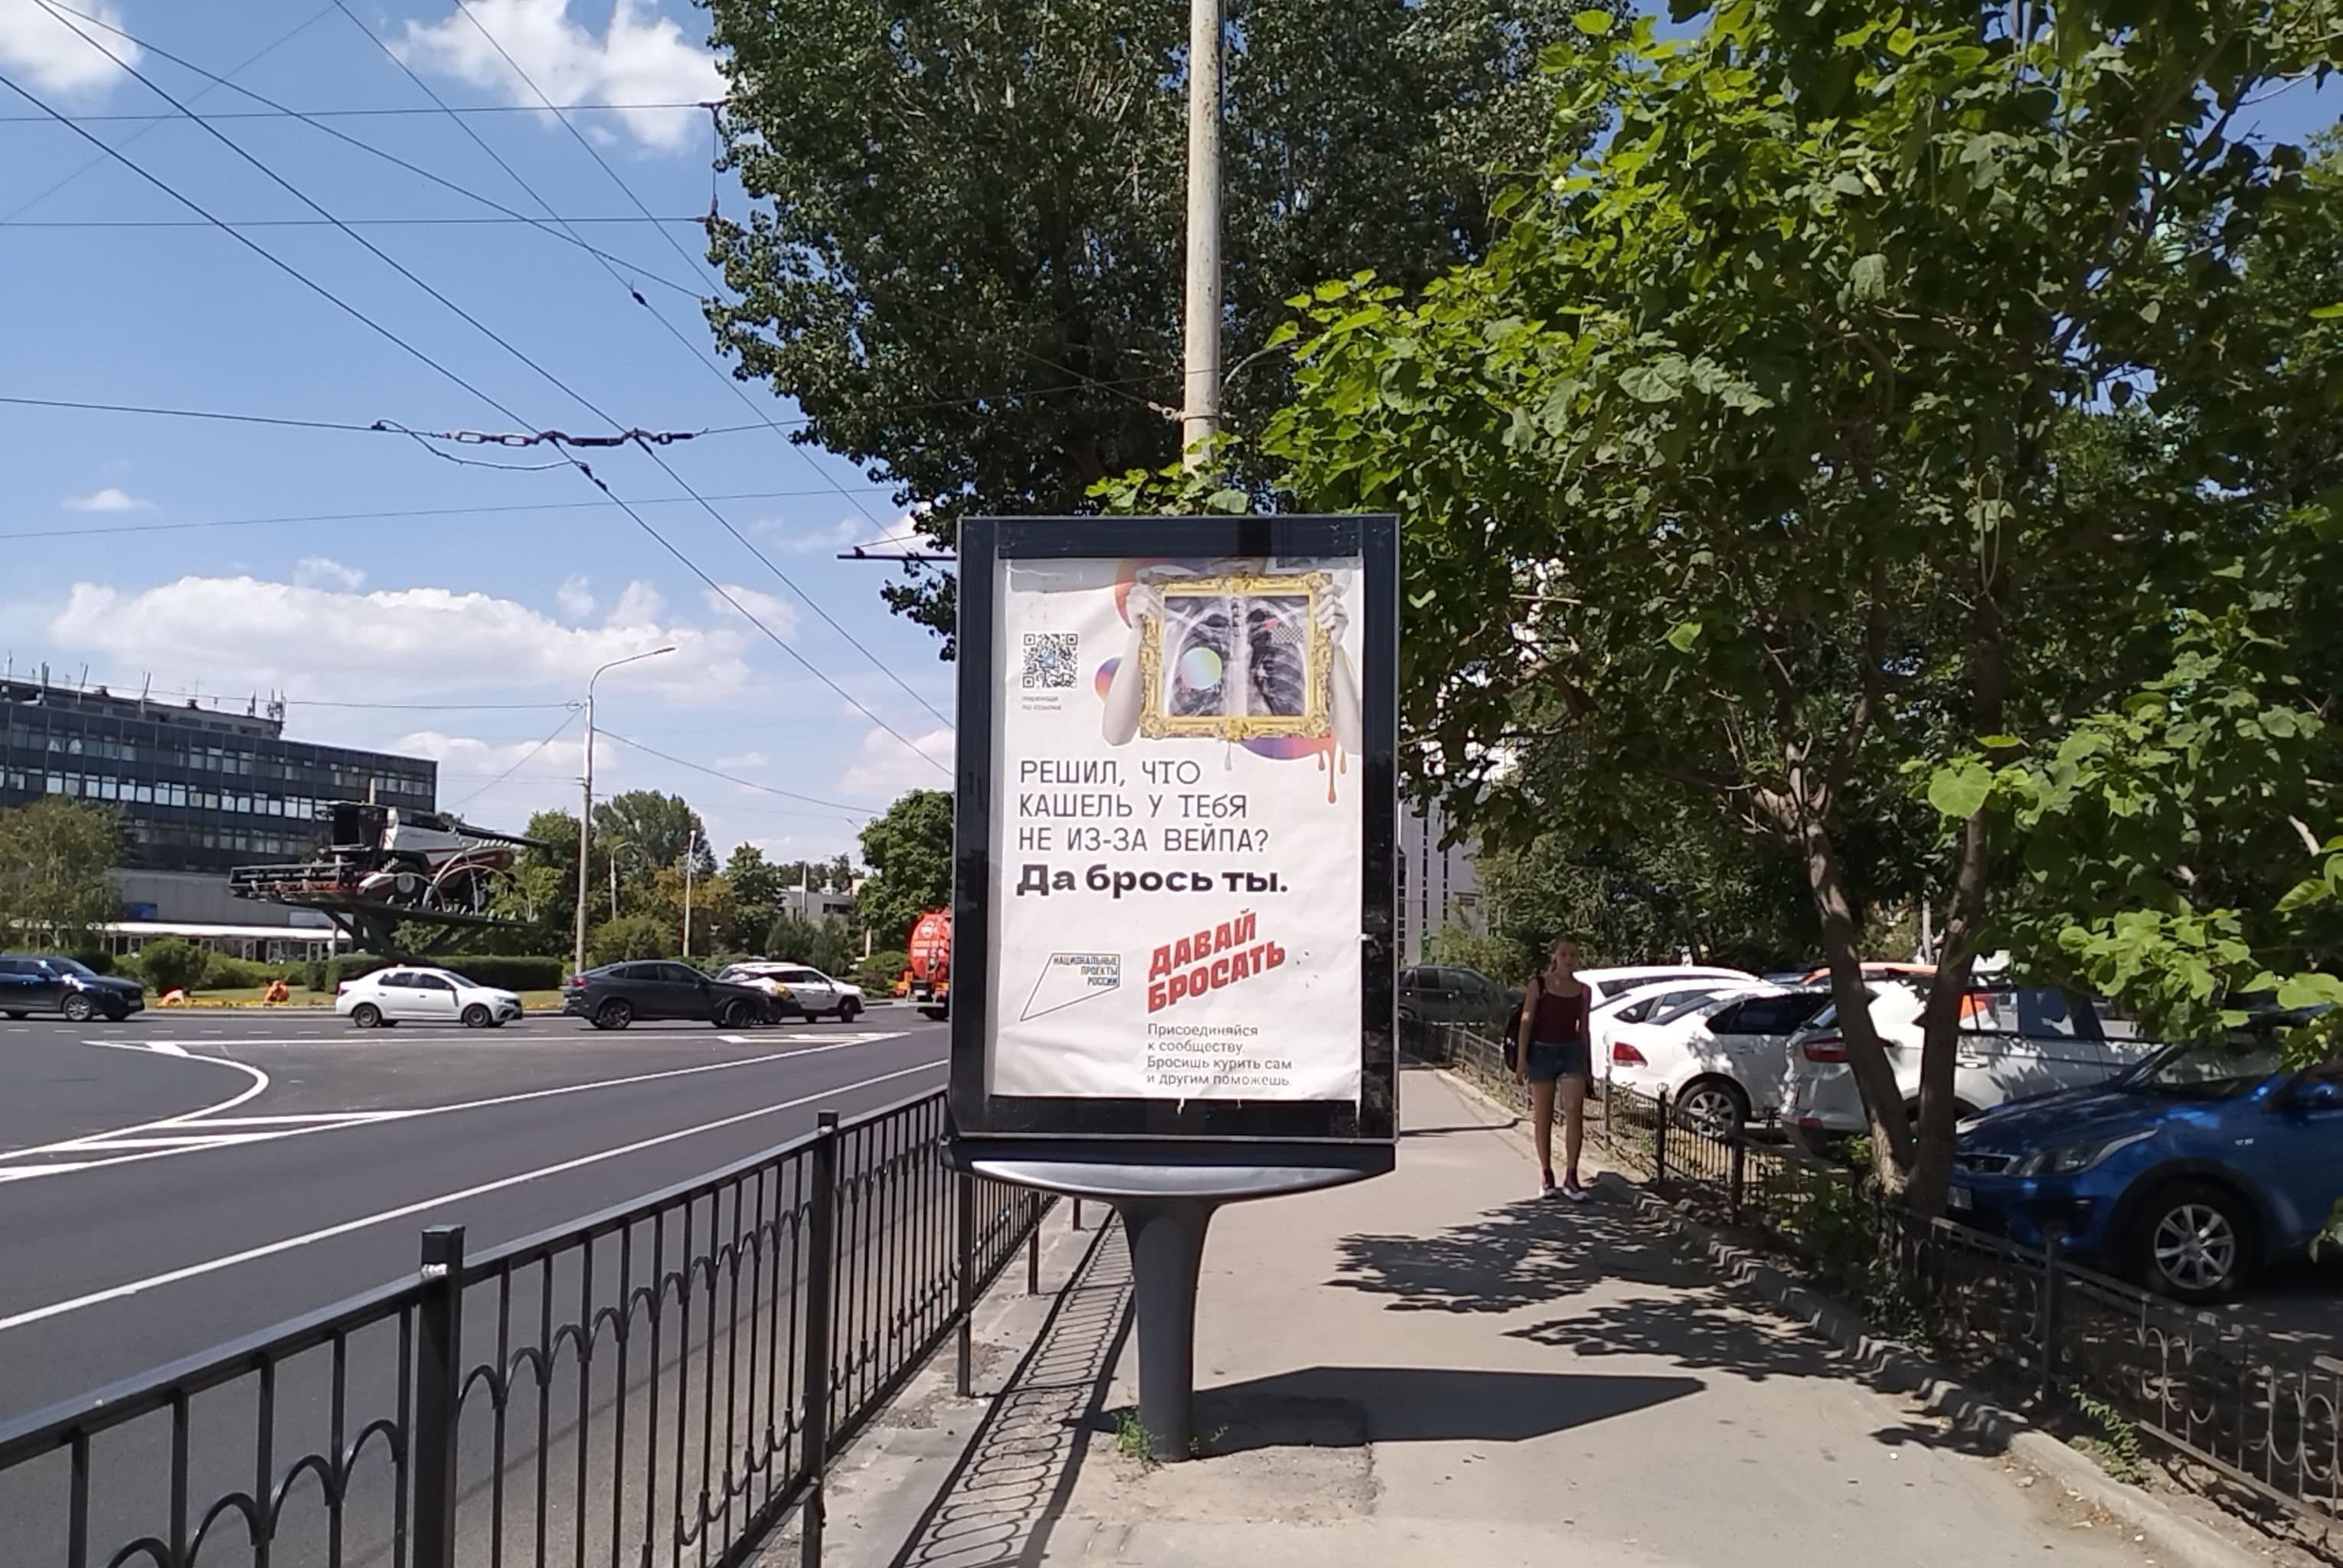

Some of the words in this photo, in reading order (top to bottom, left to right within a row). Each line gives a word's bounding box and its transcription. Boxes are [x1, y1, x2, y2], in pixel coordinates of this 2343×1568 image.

[1020, 760, 1126, 787] РЕШИЛ,
[1142, 760, 1201, 785] ЧТО
[1019, 793, 1133, 818] КАШЕЛЬ
[1149, 794, 1163, 818] У
[1018, 827, 1052, 851] НЕ
[1067, 827, 1148, 851] ИЗ-ЗА
[1164, 822, 1269, 852] ВЕЙПА?
[1016, 864, 1077, 897] Да
[1086, 864, 1213, 899] брось
[1221, 872, 1288, 893] ты.
[1149, 907, 1256, 982] ДАВАЙ
[1148, 940, 1286, 1014] БРОСАТЬ
[1148, 1023, 1259, 1037] Присоединяйся
[1148, 1042, 1155, 1051] к
[1148, 1055, 1210, 1070] Бросишь
[1213, 1059, 1261, 1072] курить
[1264, 1060, 1292, 1070] сам
[1147, 1074, 1155, 1083] и
[1158, 1073, 1210, 1087] другим
